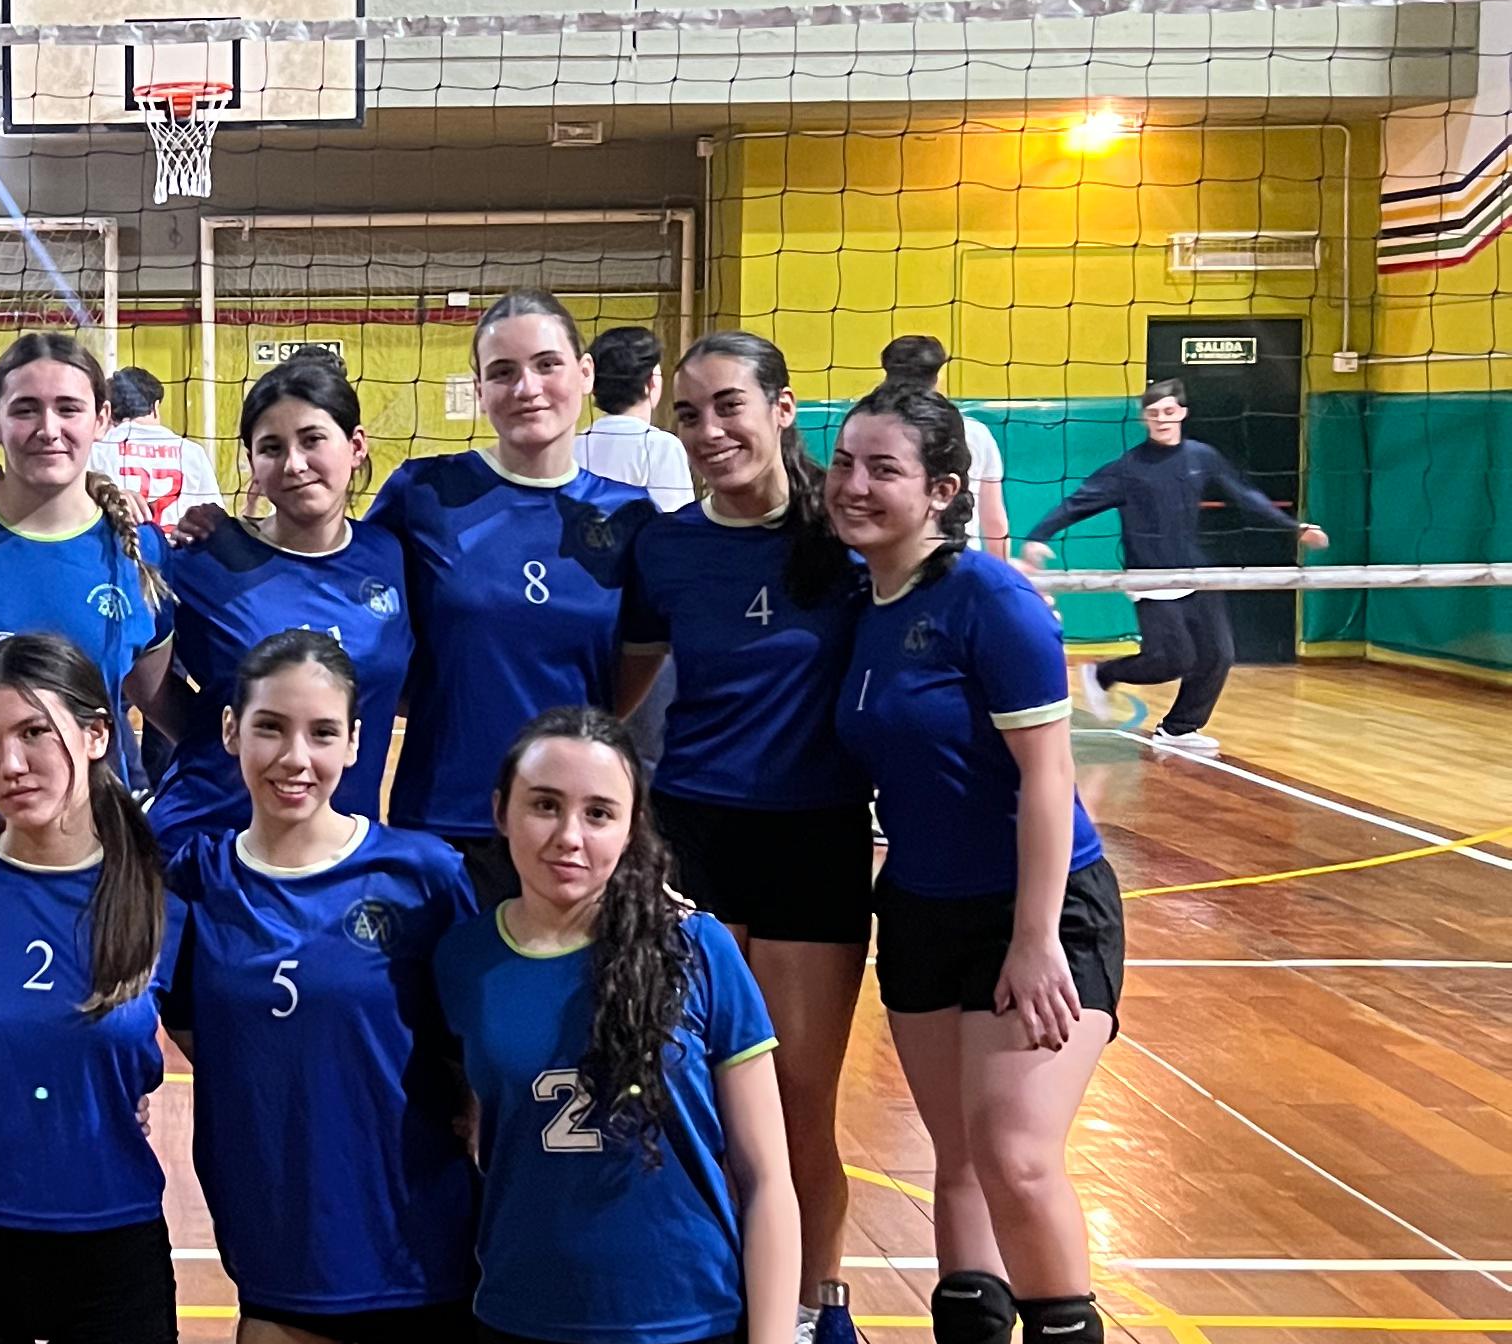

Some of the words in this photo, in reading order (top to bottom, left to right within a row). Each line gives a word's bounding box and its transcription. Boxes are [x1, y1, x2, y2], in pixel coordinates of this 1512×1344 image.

[1195, 341, 1243, 353] SALIDA
[523, 560, 550, 604] 8
[745, 585, 774, 626] 4
[23, 940, 55, 990] 2
[271, 960, 299, 1017] 5
[531, 1068, 604, 1152] 2
